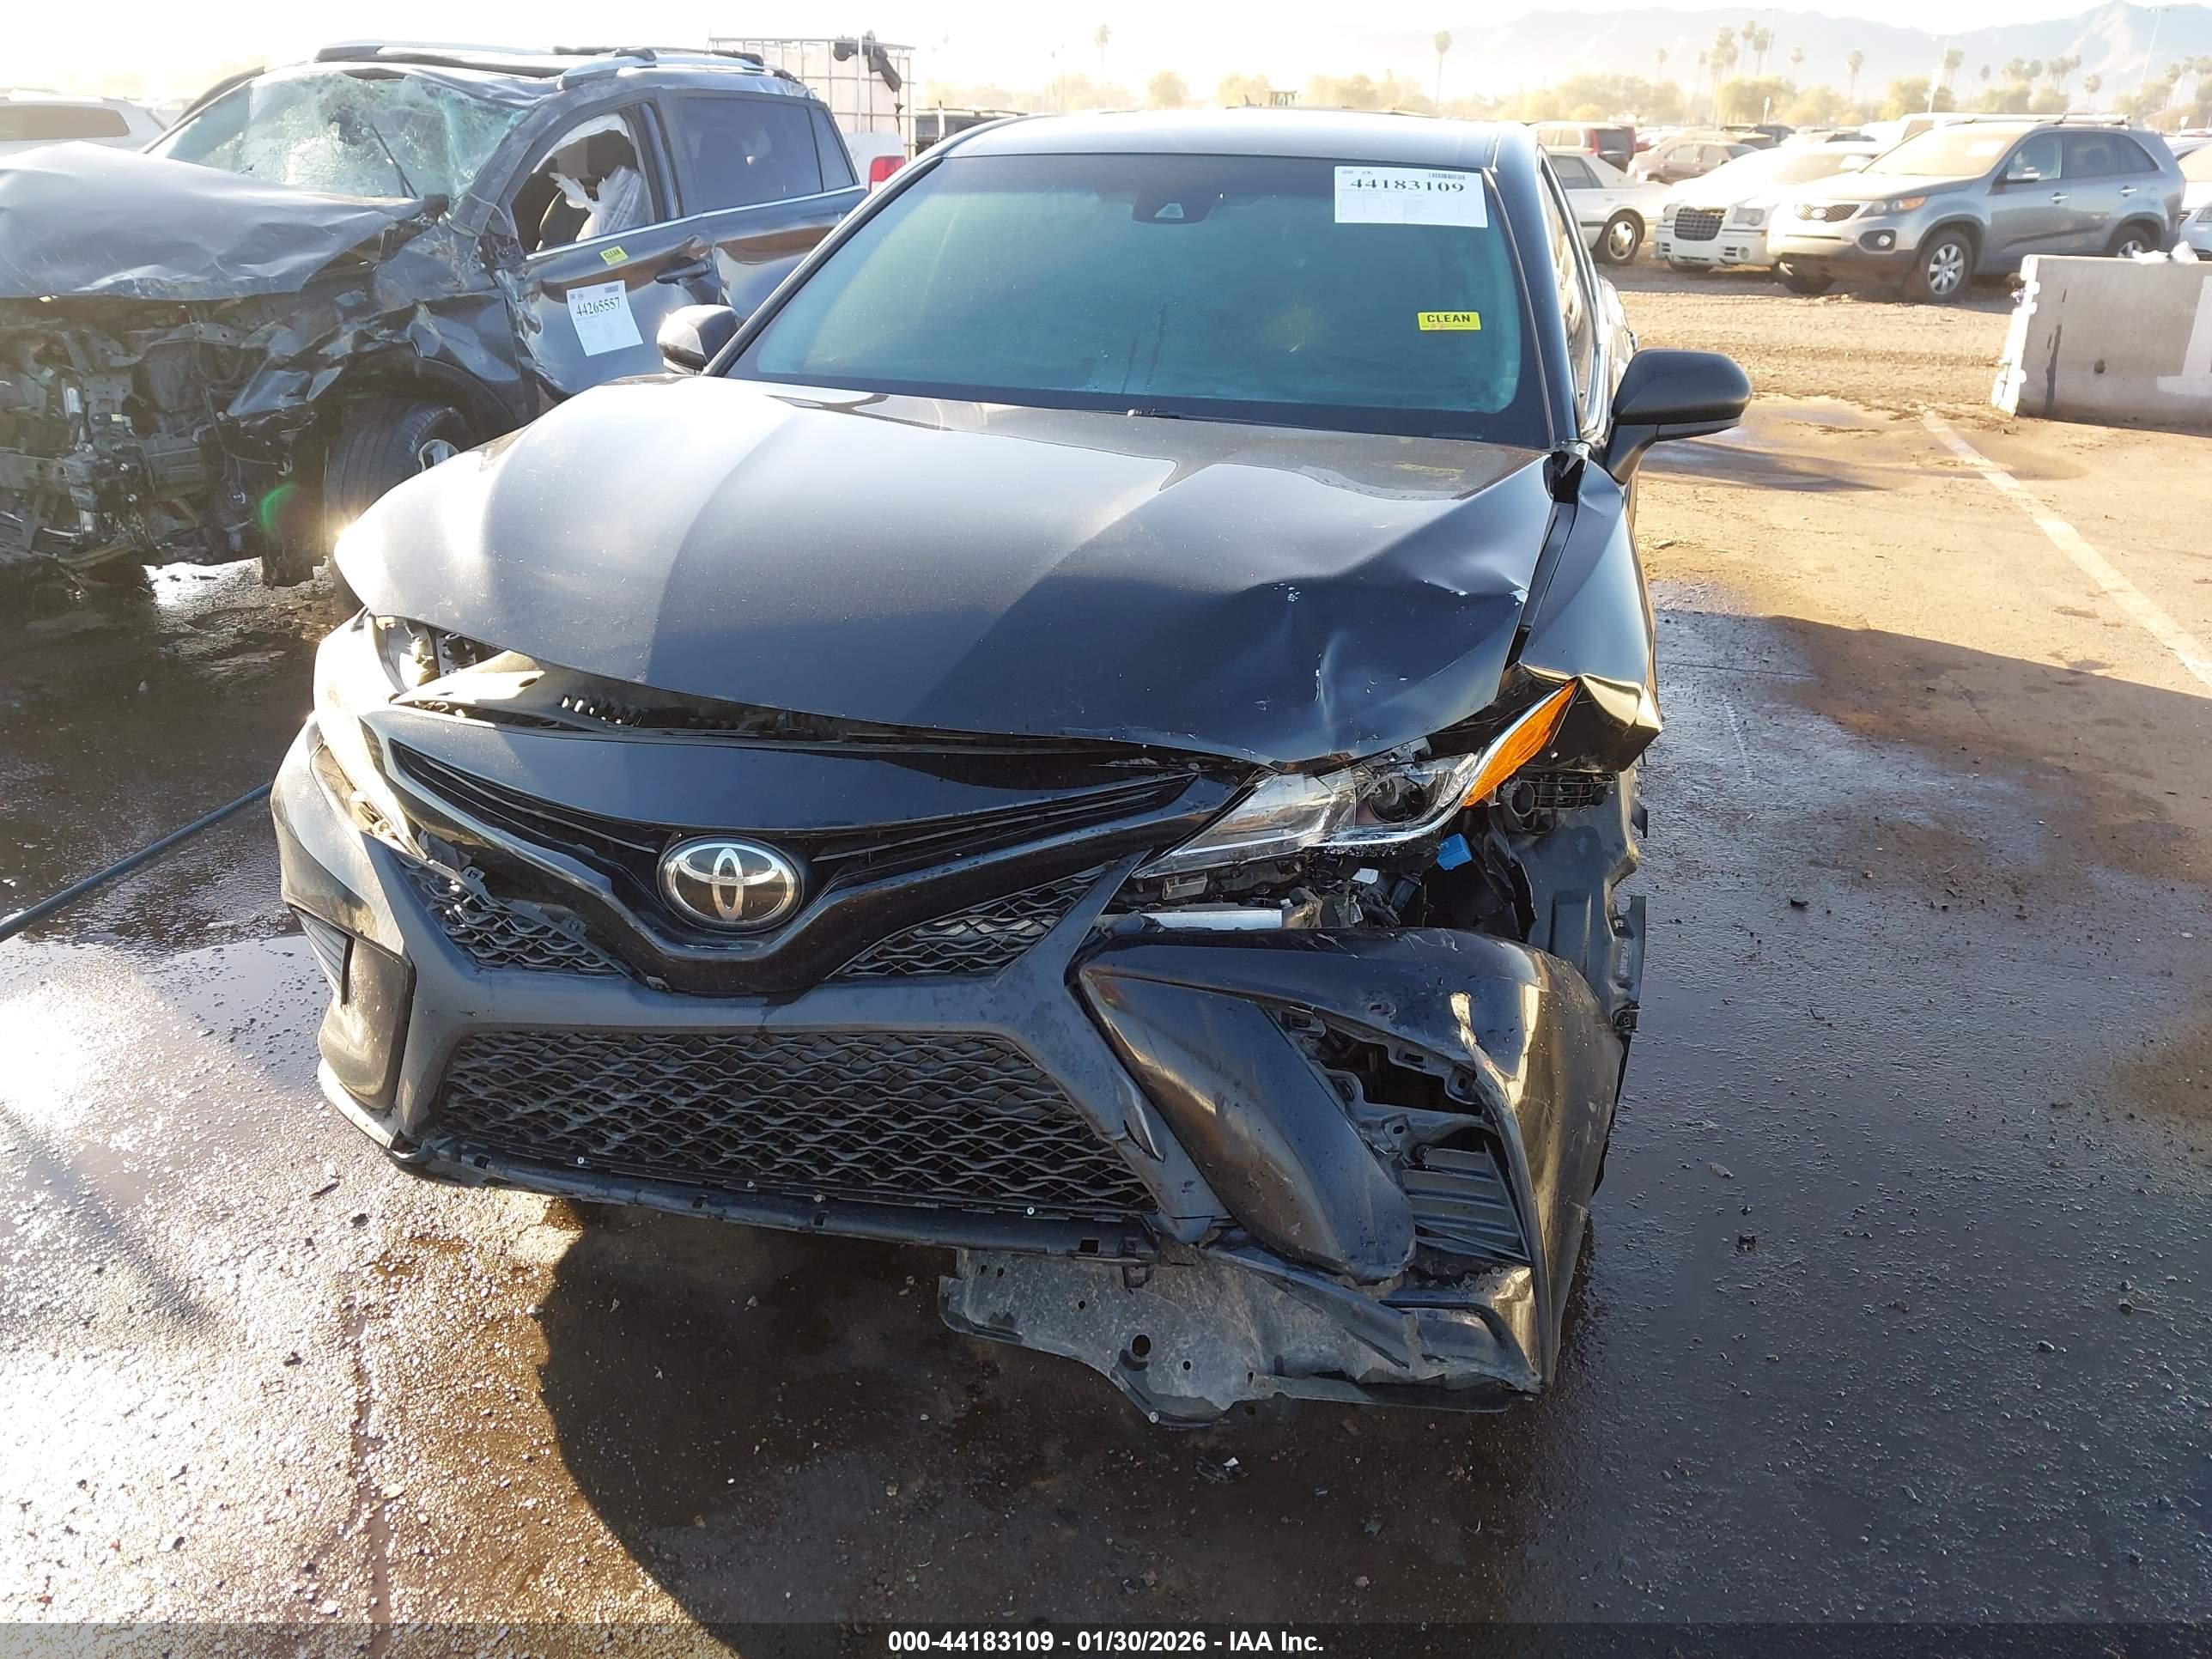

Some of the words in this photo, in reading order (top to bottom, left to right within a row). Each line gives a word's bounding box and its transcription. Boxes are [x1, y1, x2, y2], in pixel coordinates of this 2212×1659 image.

[1350, 178, 1465, 191] 44183109
[576, 296, 620, 316] 44265557
[1426, 314, 1471, 323] CLEAN
